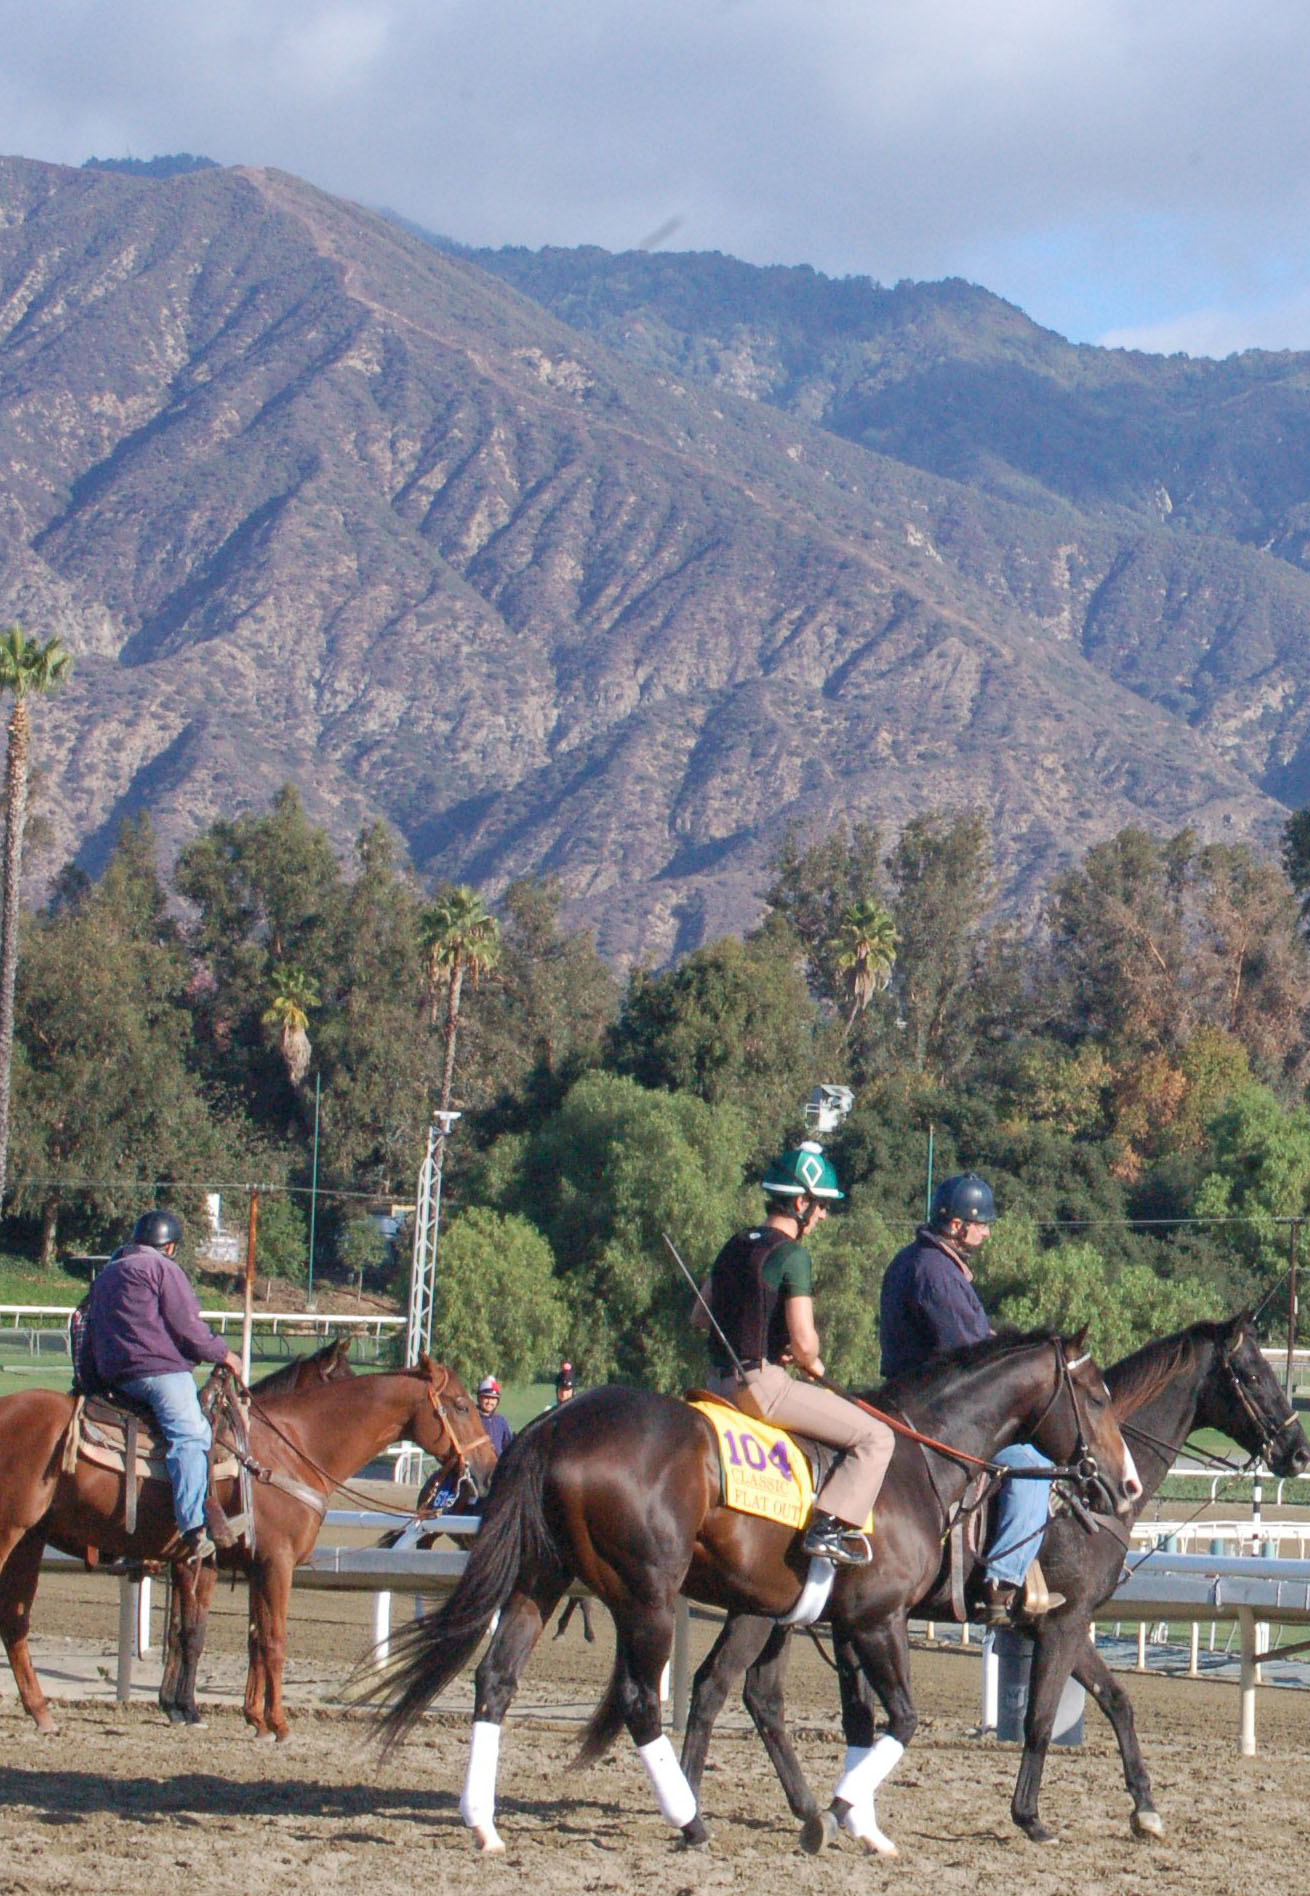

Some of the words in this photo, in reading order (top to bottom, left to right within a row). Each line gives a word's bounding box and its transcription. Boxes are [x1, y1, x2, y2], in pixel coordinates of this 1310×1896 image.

[723, 1429, 793, 1481] 104
[731, 1468, 790, 1494] CLASSIC
[735, 1491, 768, 1512] FLAT
[773, 1501, 800, 1521] OUT
